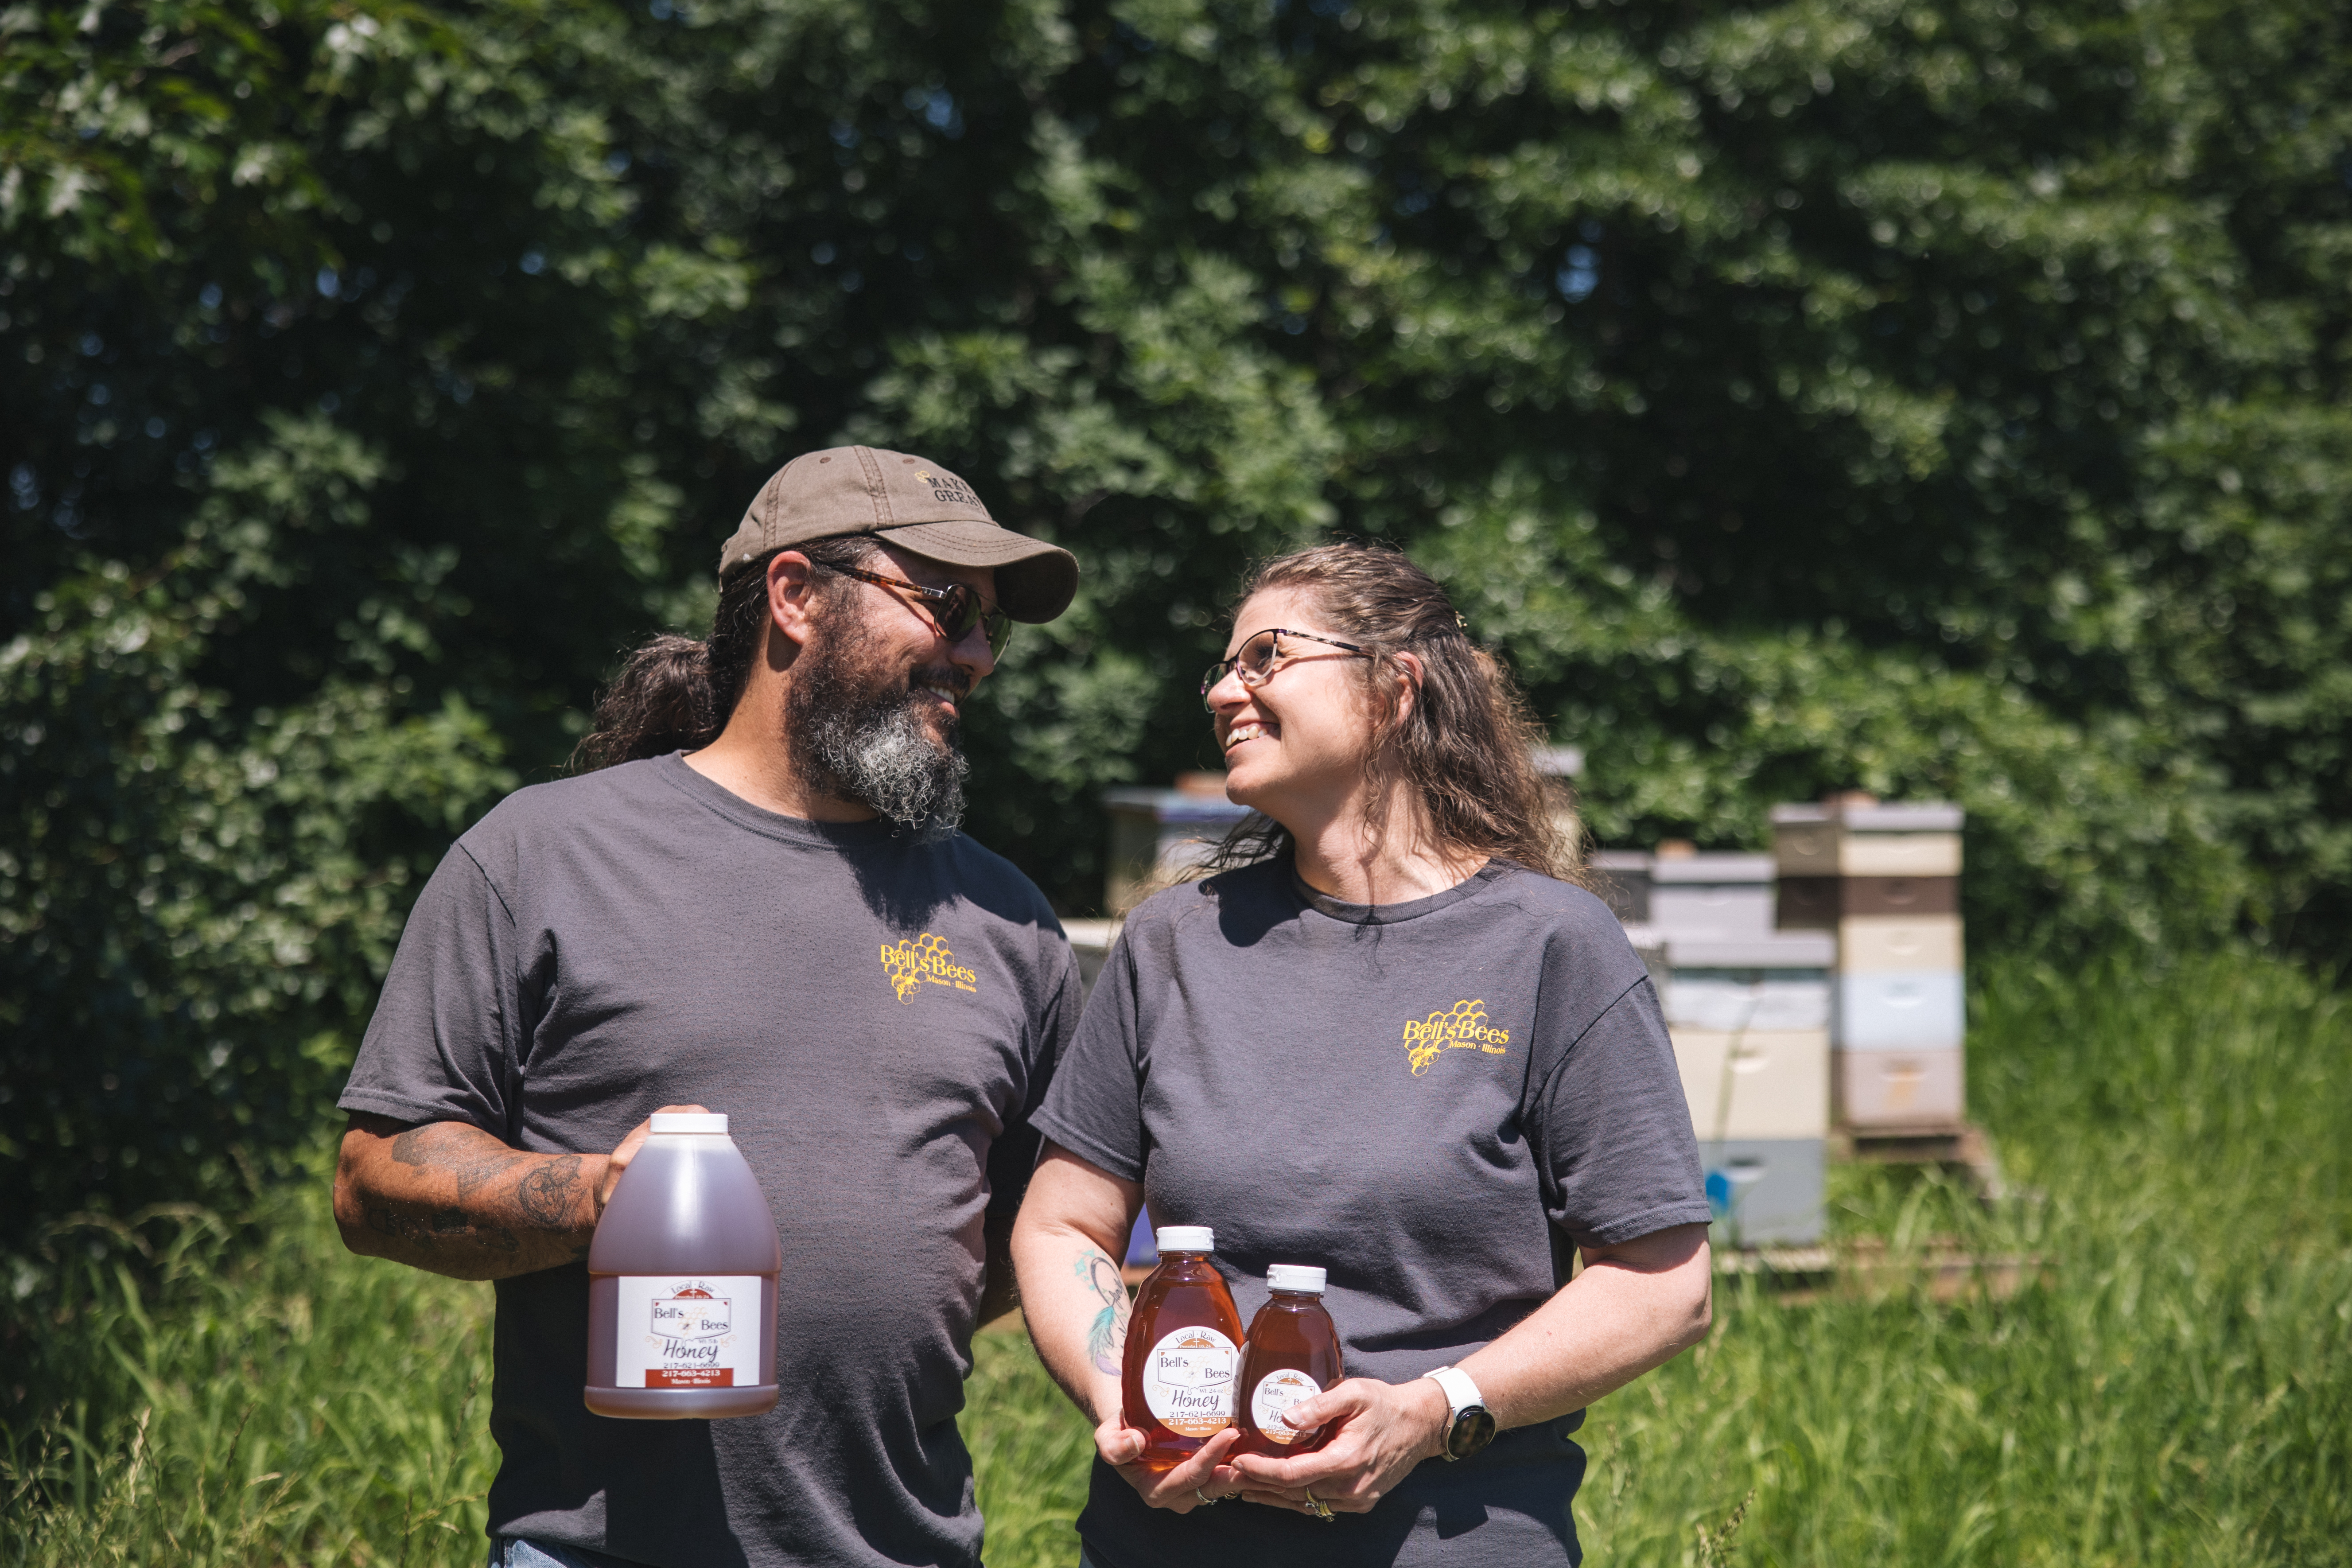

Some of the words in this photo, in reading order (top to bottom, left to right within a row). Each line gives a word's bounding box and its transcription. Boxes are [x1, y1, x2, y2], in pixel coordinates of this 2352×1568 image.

[925, 478, 972, 494] MAKE
[880, 944, 930, 972] Bell's
[932, 956, 976, 983] Bees
[927, 974, 951, 987] Mason
[955, 980, 977, 993] Illinois
[1403, 1020, 1457, 1040] Bell's
[1458, 1020, 1509, 1044] Bees
[1449, 1040, 1476, 1050] Mason
[1482, 1043, 1506, 1054] Illinois
[671, 1281, 692, 1294] Local
[699, 1281, 715, 1293] Raw
[655, 1307, 684, 1318] Bell's
[701, 1319, 728, 1330] Bees
[1175, 1331, 1194, 1343] Local
[1200, 1331, 1216, 1342] Raw
[663, 1339, 720, 1363] Honey
[1161, 1357, 1189, 1368] Bell's
[1205, 1368, 1230, 1378] Bees
[1293, 1373, 1305, 1382] Raw
[1264, 1388, 1283, 1396] Bell's
[1172, 1389, 1221, 1411] Honey
